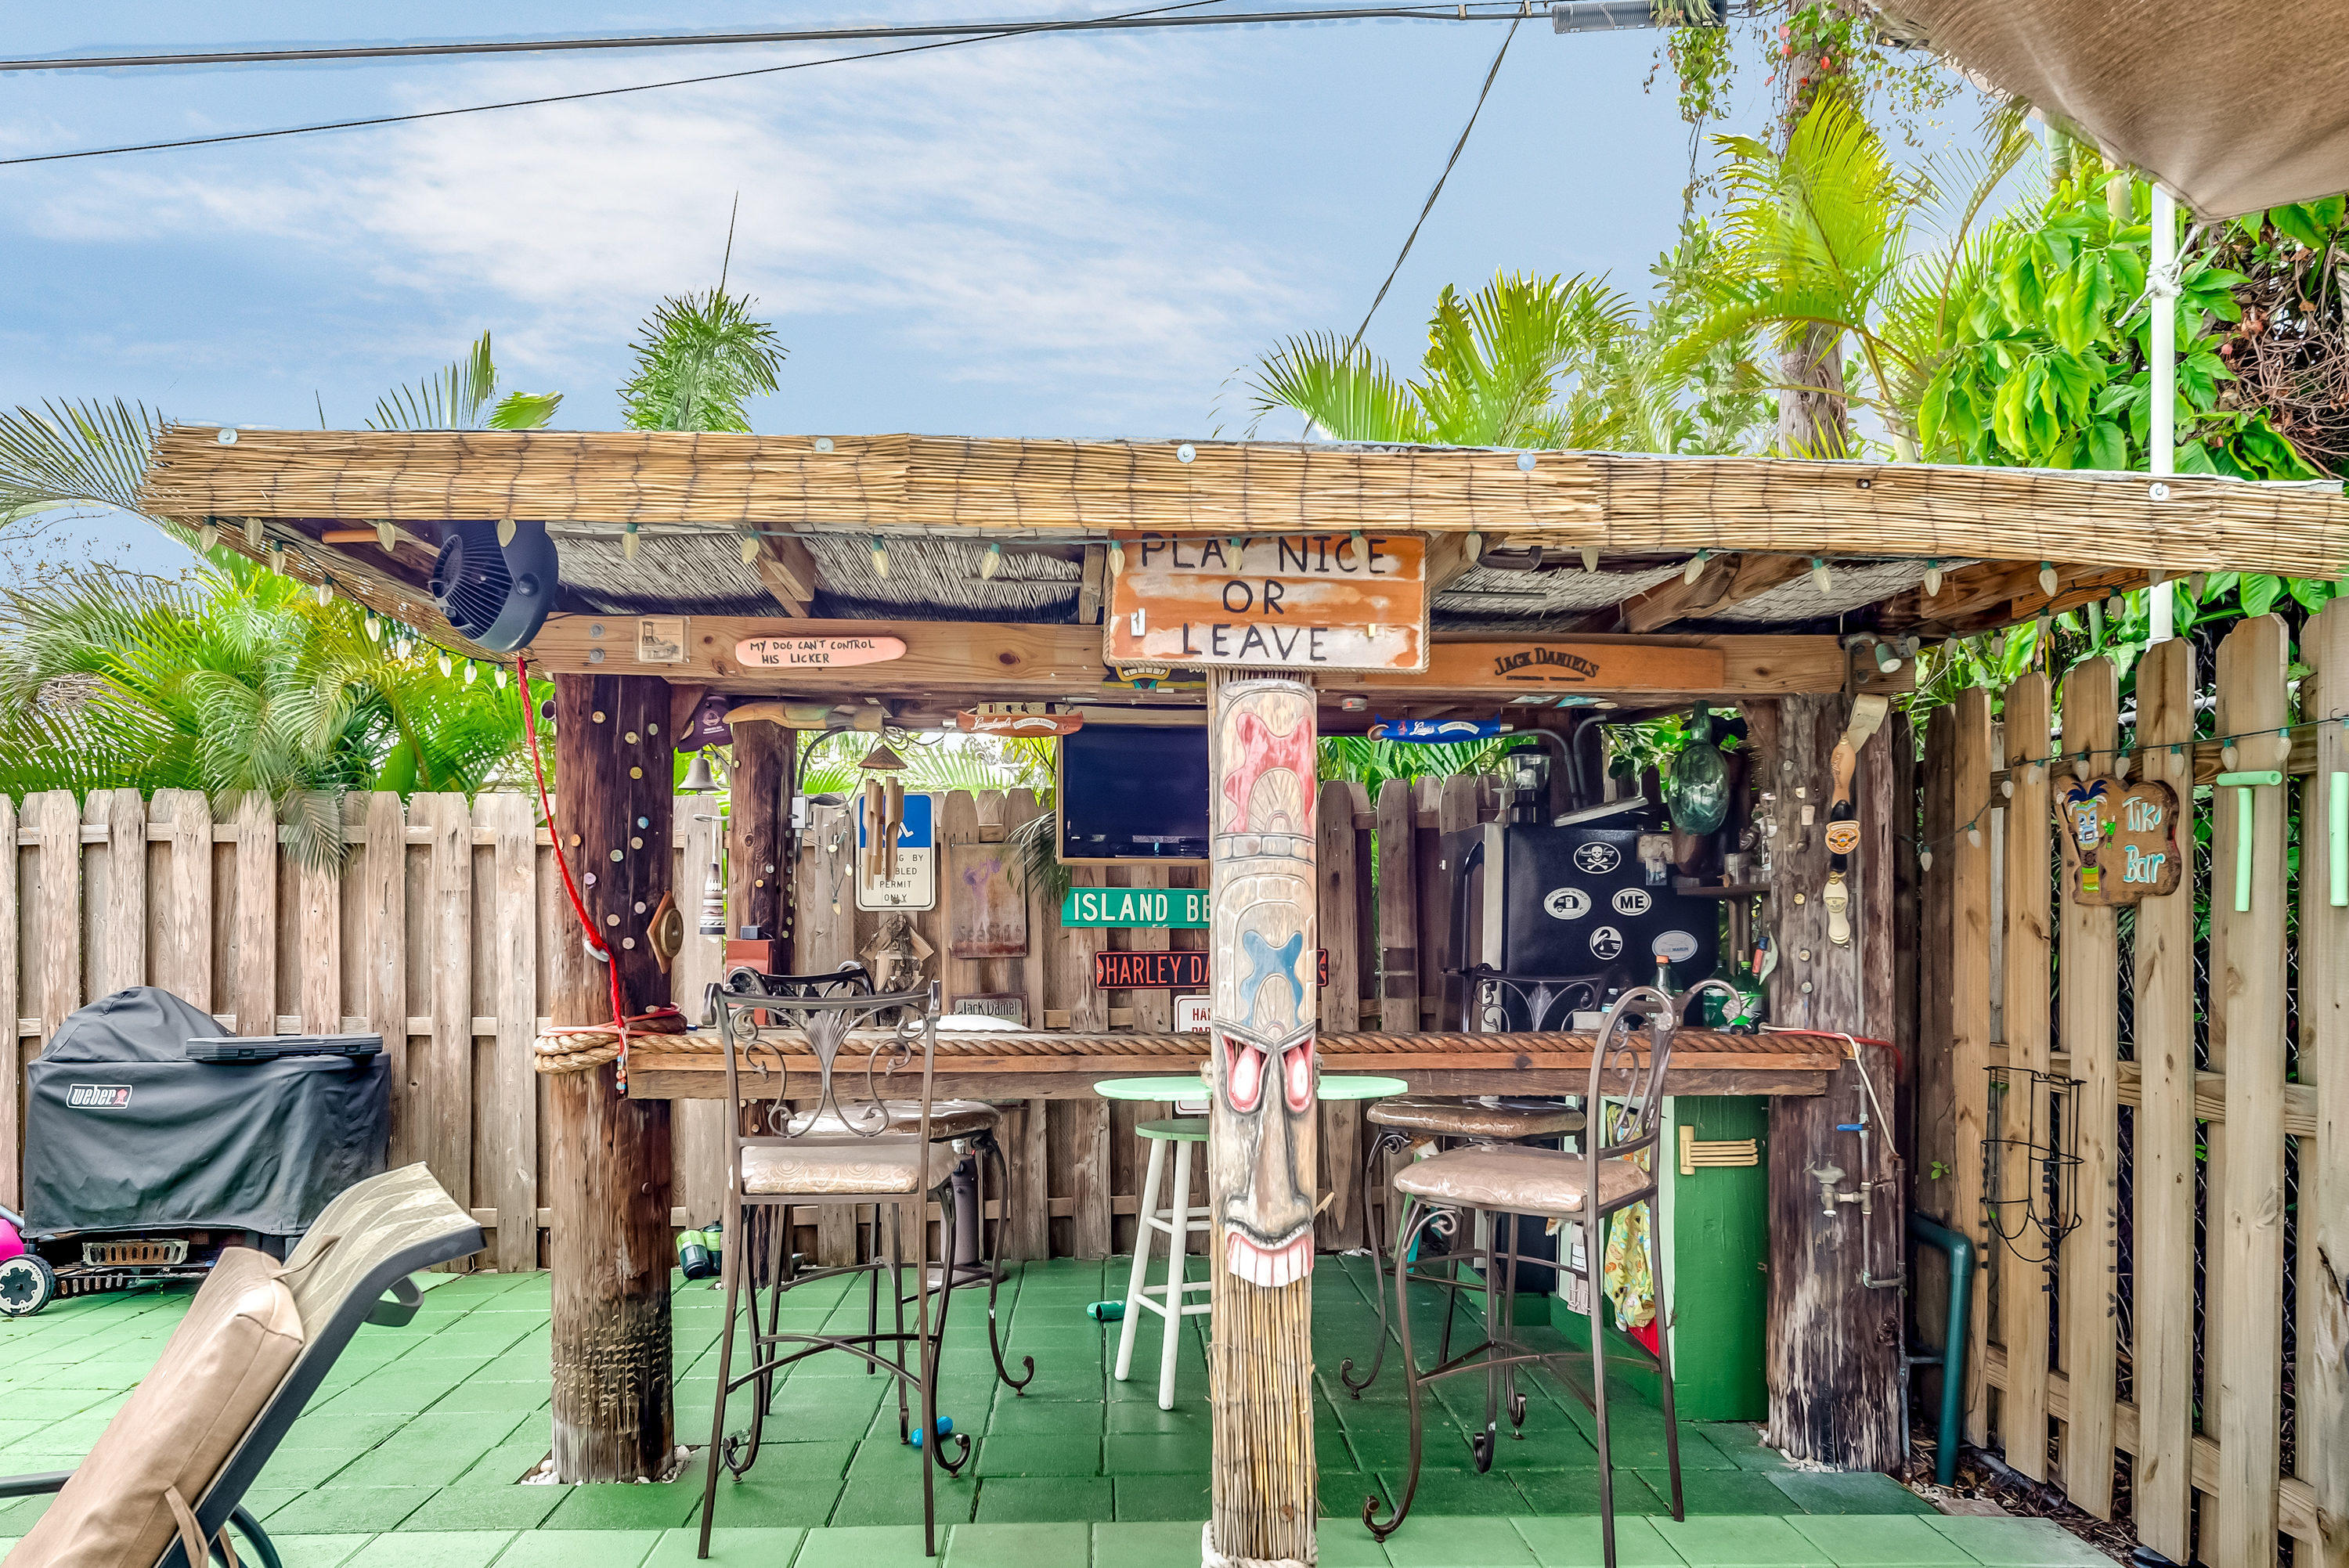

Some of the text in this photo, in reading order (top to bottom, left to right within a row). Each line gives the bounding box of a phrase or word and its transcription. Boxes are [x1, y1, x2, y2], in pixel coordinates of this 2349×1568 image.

[1278, 535, 1387, 573] NICE
[1222, 579, 1284, 615] OR
[750, 640, 876, 653] MY DOG CAN'T CONTROL
[1182, 622, 1329, 661] LEAVE
[762, 653, 830, 664] HIS LICKER
[2123, 845, 2166, 884] Bar
[1074, 892, 1168, 921] ISLAND
[1620, 896, 1644, 909] ME
[1106, 956, 1182, 984] HARLEY
[71, 1086, 117, 1105] weber
